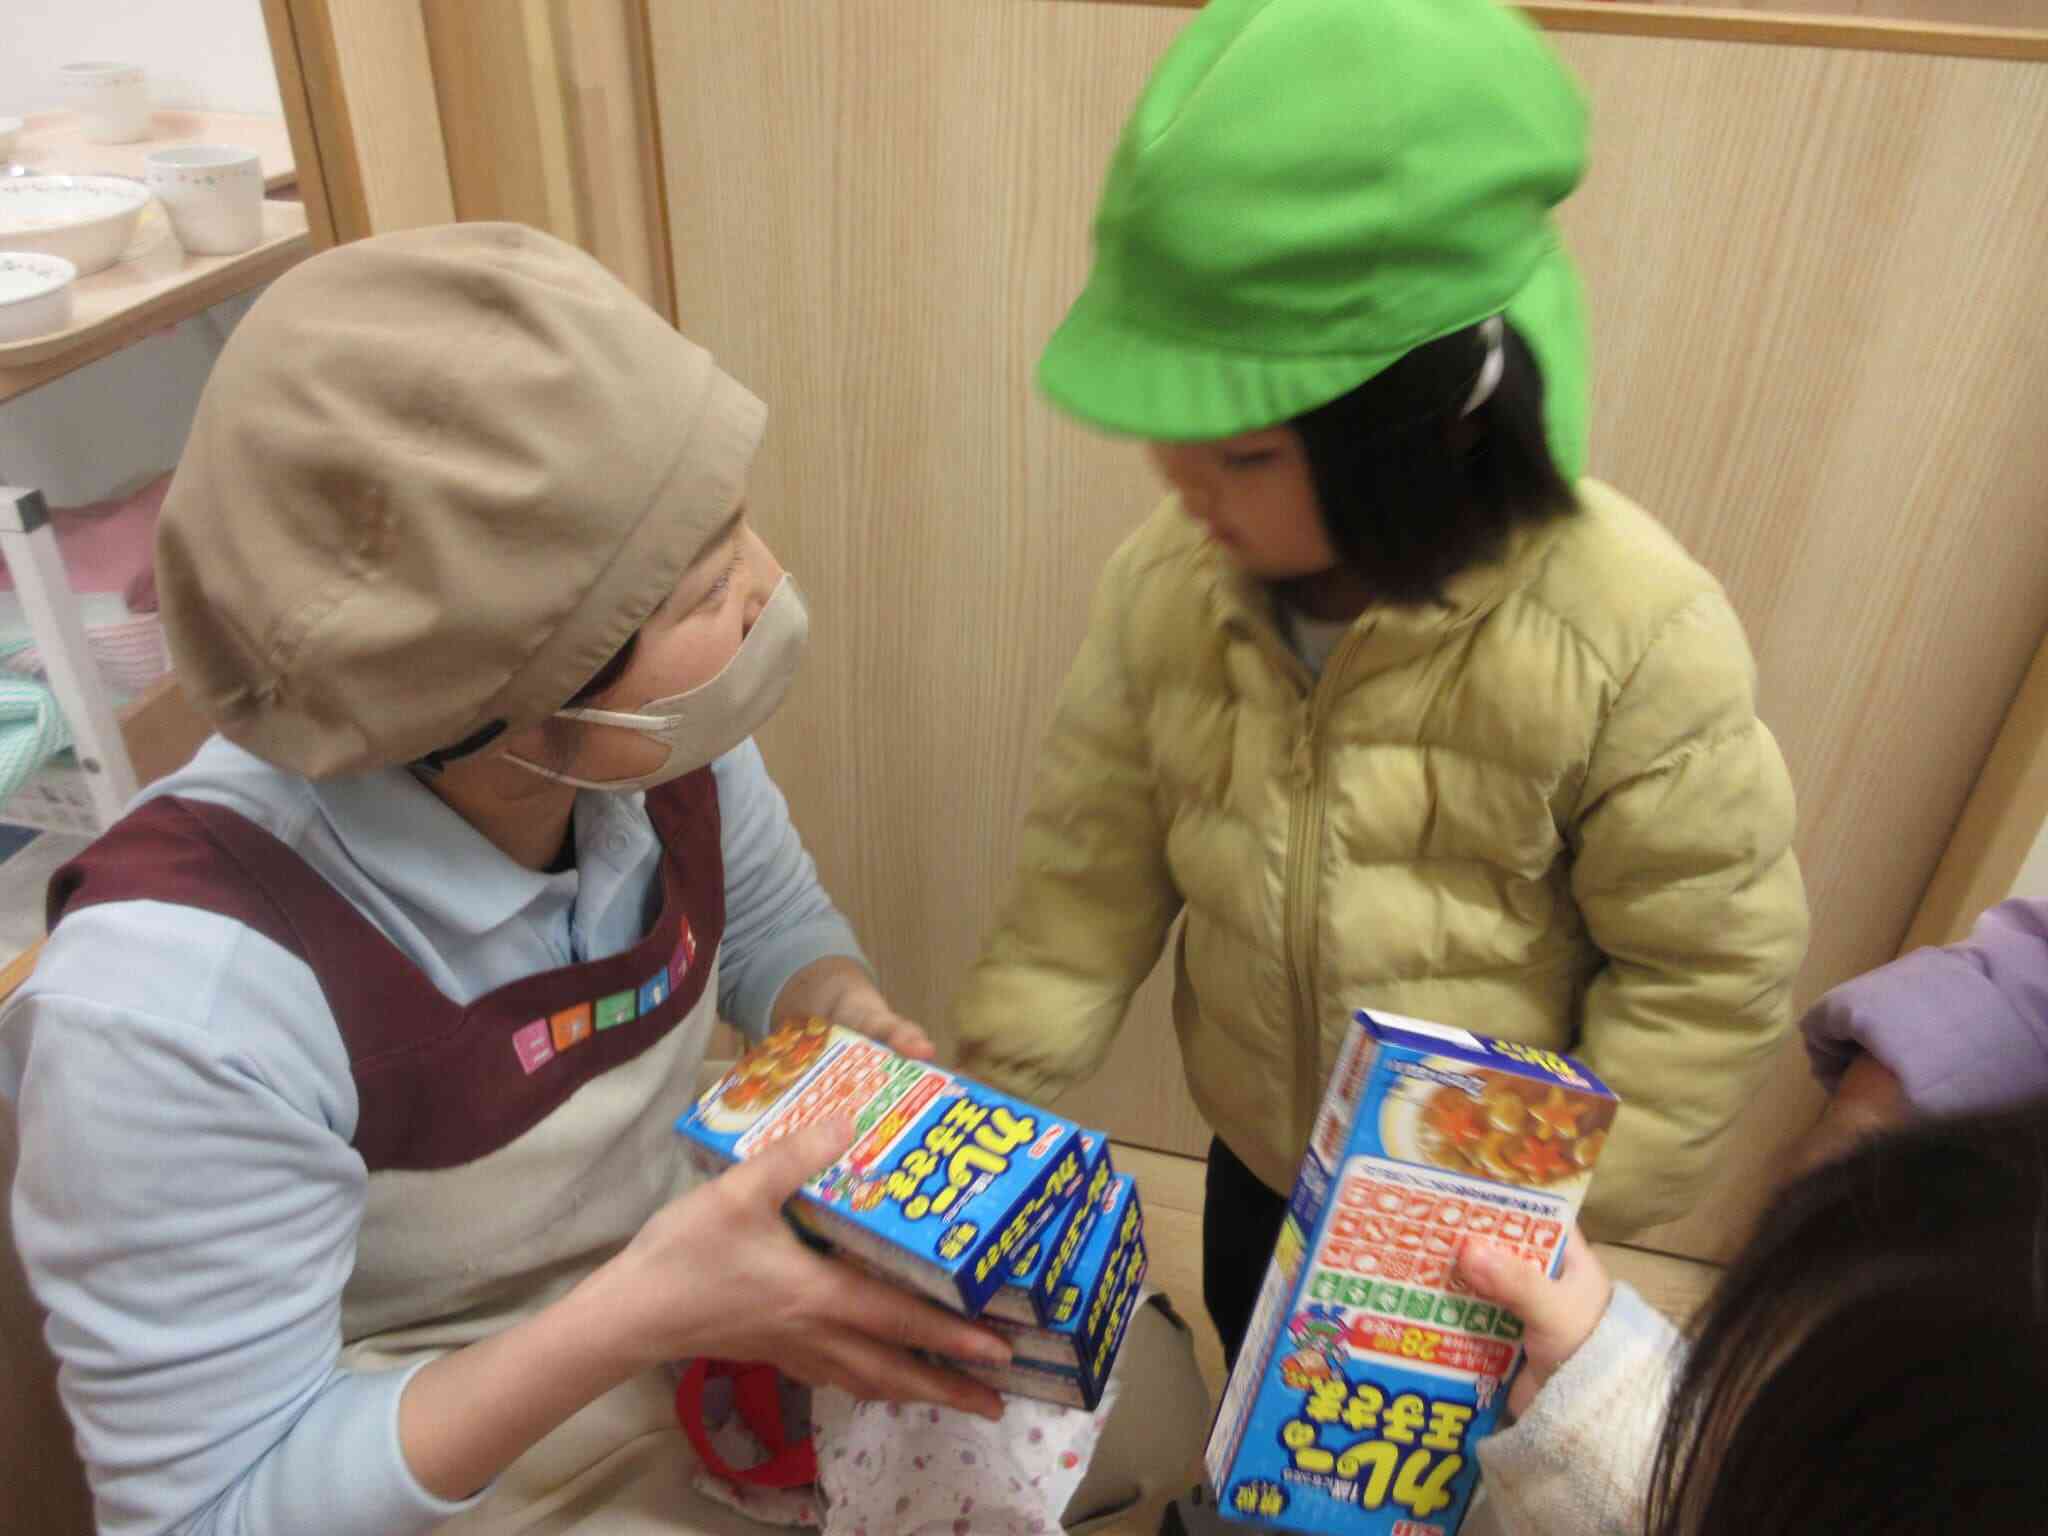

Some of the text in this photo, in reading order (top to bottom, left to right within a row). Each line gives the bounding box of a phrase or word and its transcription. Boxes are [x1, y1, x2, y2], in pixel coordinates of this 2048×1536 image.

[886, 1096, 989, 1201] 王子さま
[1306, 1376, 1473, 1450] 王子さま
